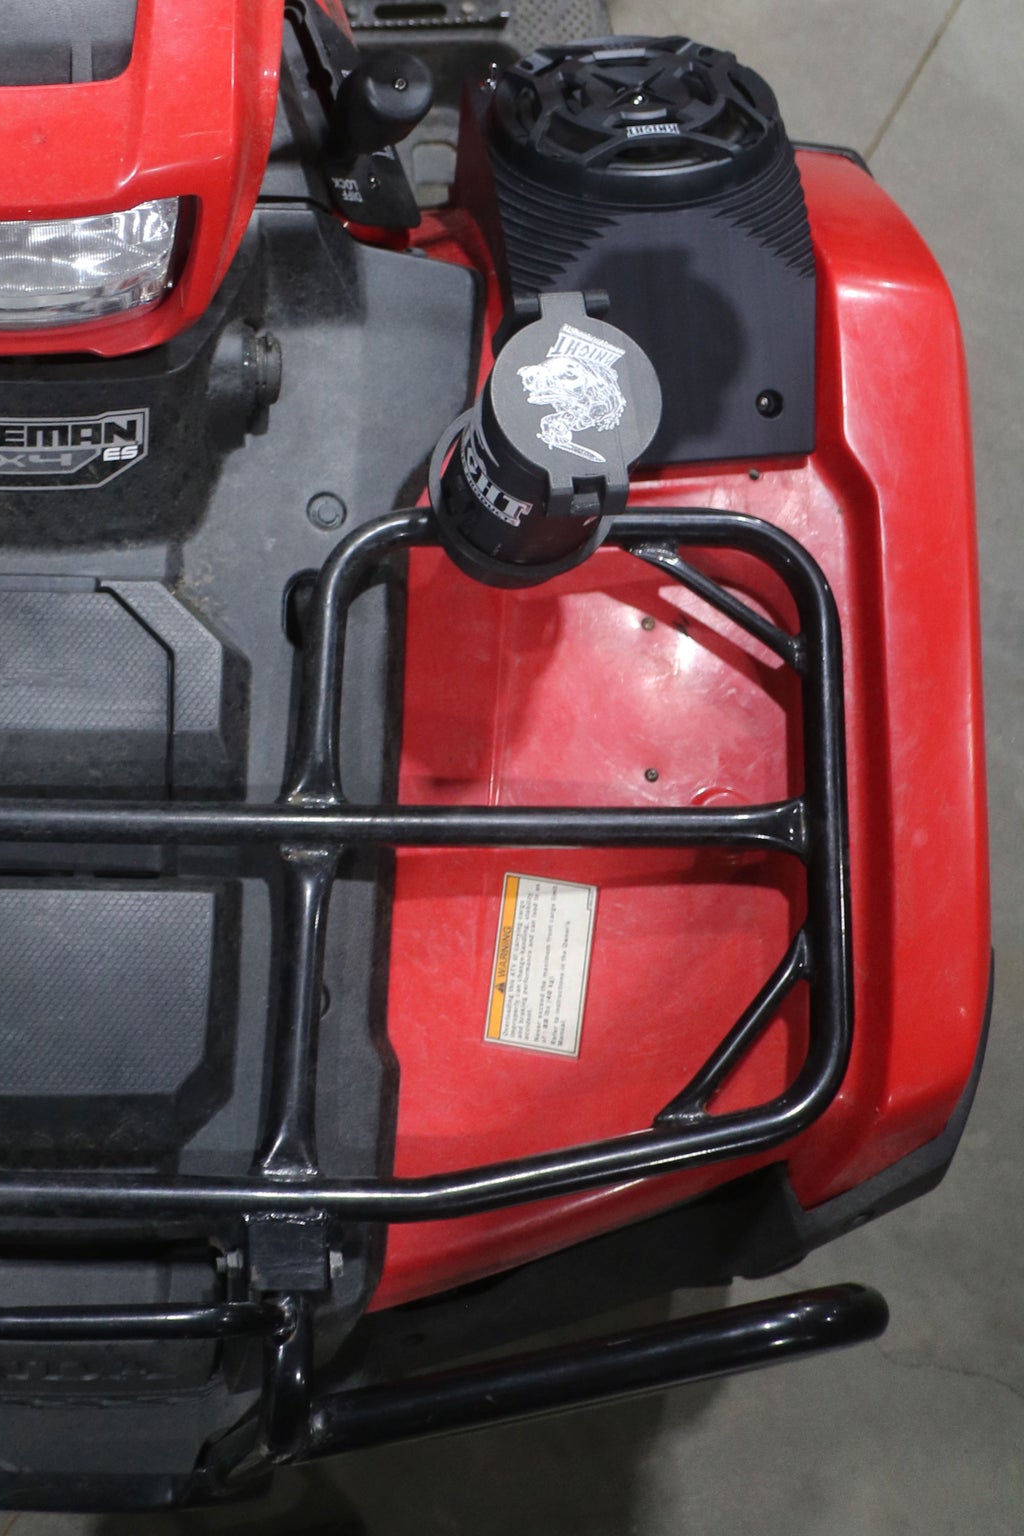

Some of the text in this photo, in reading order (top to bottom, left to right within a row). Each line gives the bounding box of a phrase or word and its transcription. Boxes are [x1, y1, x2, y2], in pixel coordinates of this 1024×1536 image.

[627, 123, 680, 138] KNIGHT
[550, 335, 618, 366] KNIGHT
[102, 445, 139, 462] ES
[497, 925, 512, 978] WARNING
